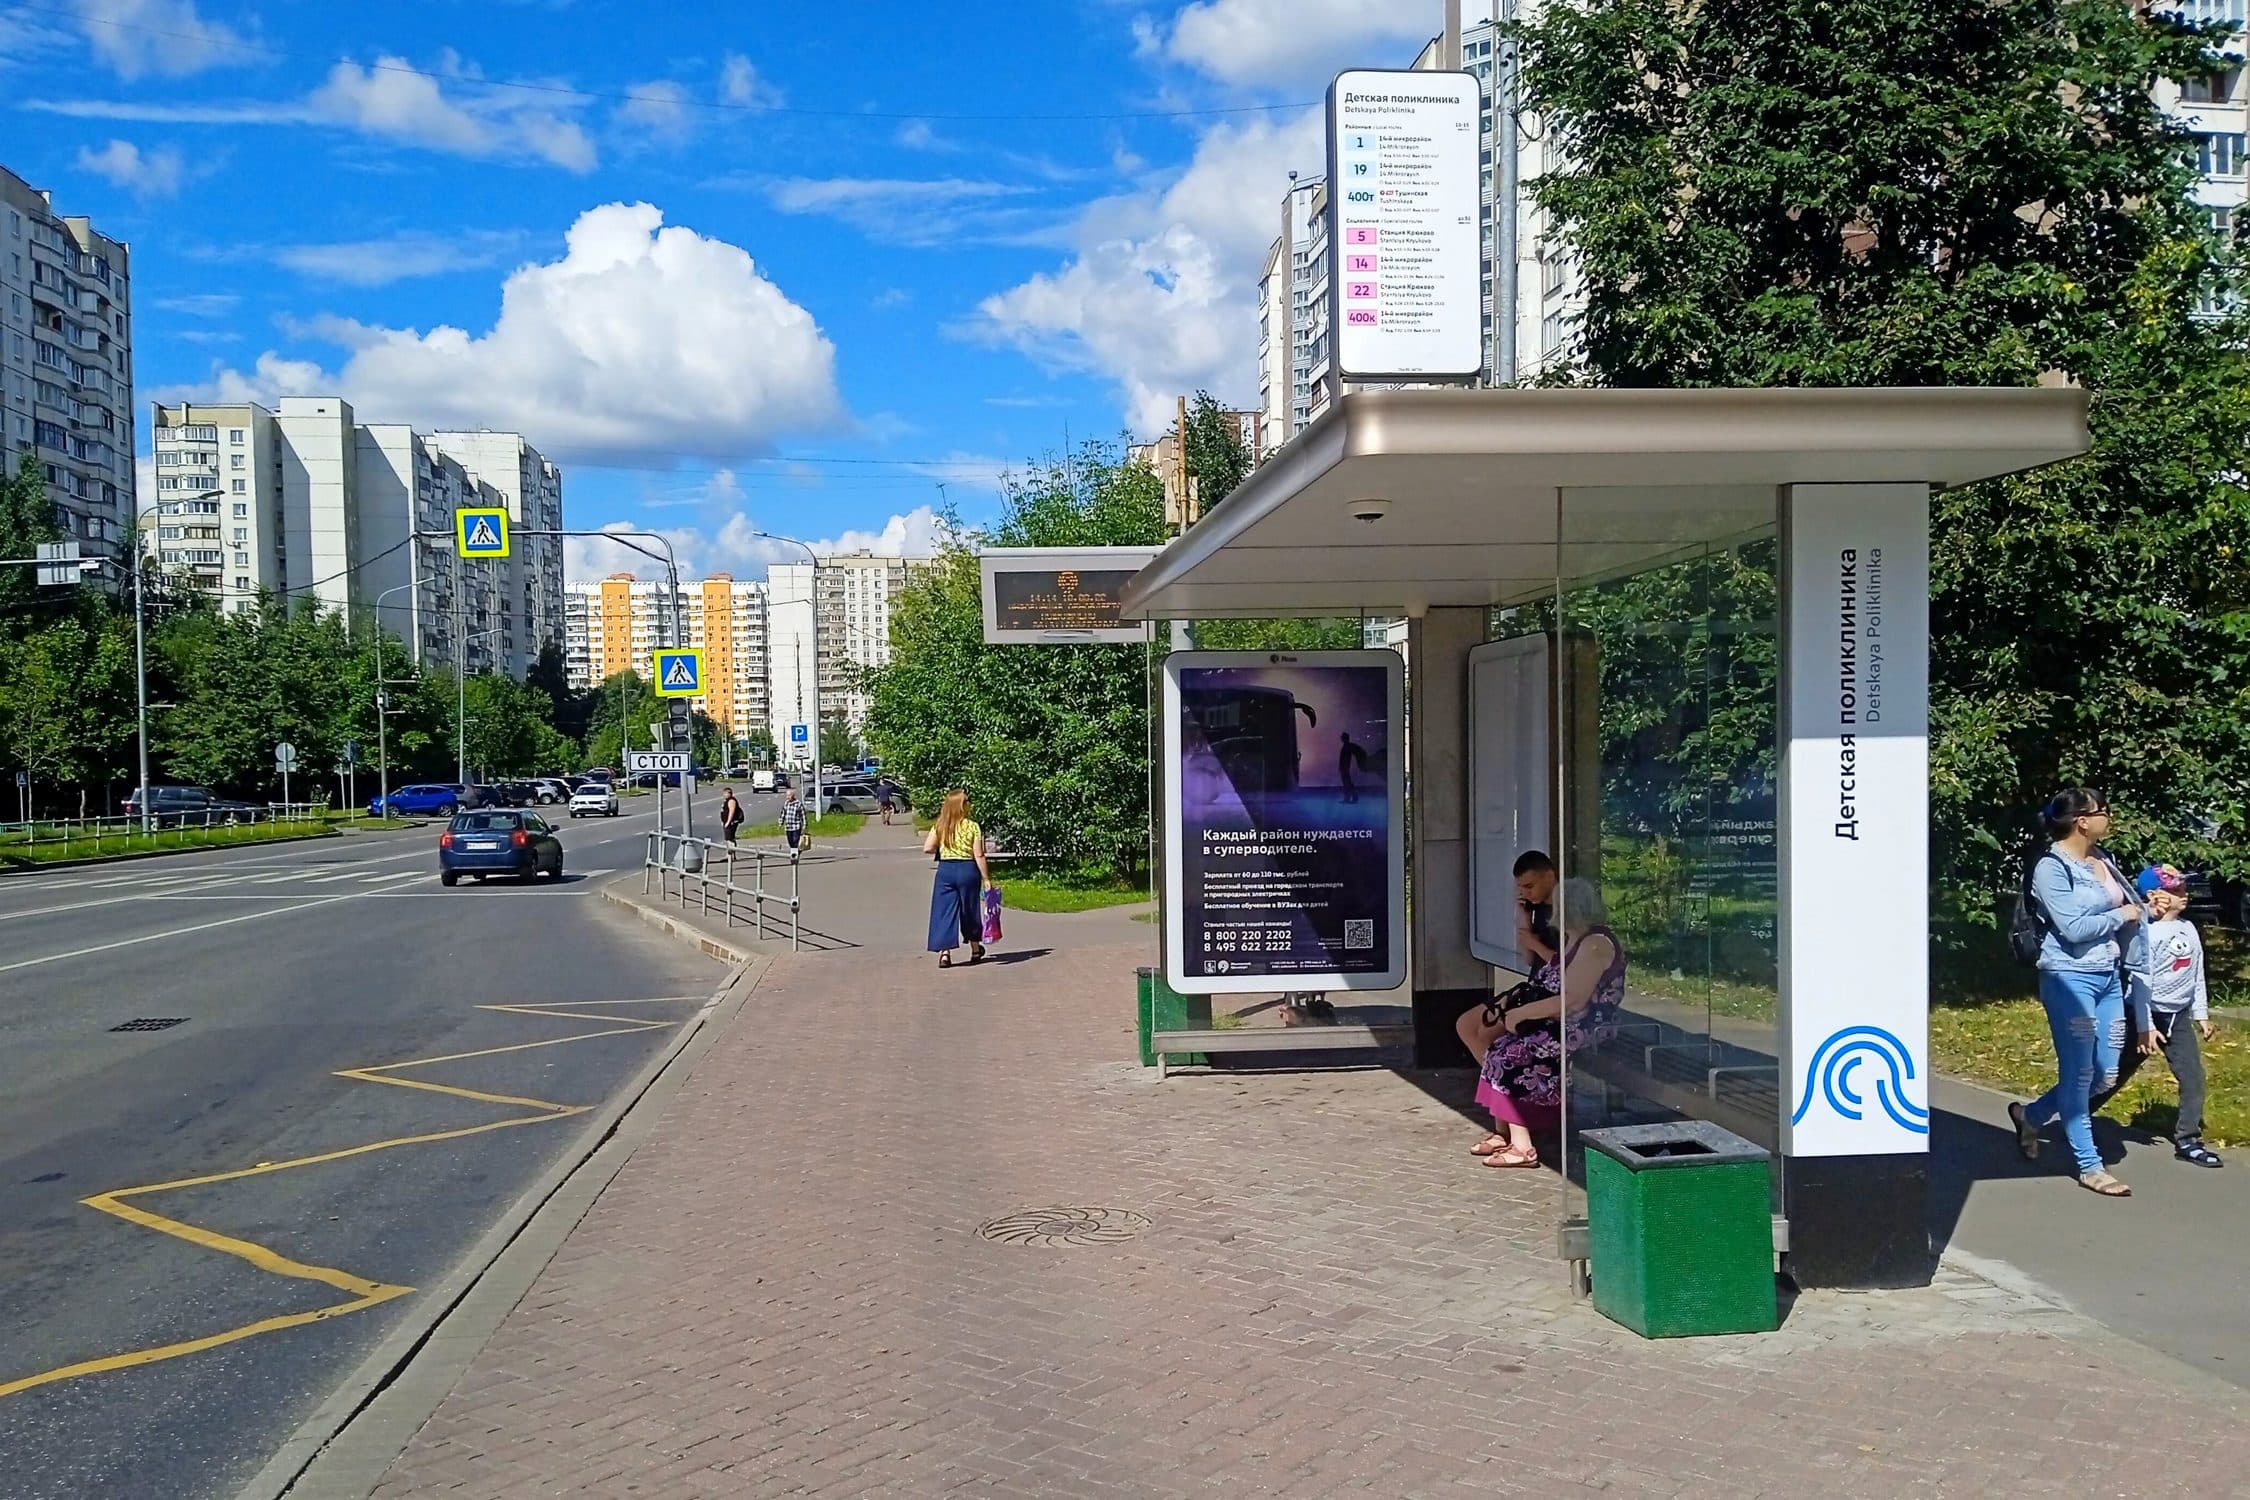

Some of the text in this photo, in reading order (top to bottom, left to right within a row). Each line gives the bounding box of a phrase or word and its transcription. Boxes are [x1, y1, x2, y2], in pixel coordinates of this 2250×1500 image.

[1345, 93, 1460, 104] Детская поликлиника
[1345, 106, 1376, 114] Detskaya
[1357, 138, 1363, 147] 1
[1355, 164, 1367, 175] 19
[1348, 192, 1374, 201] 400т
[1358, 231, 1365, 241] 5
[1355, 259, 1368, 269] 14
[1354, 286, 1369, 296] 22
[1866, 548, 1884, 722] Detskaya Poliklinika
[1835, 549, 1858, 841] Детская поликлиника
[795, 728, 804, 739] P
[638, 756, 681, 768] СТОП
[1203, 828, 1372, 843] Каждый район нуждается
[1214, 844, 1317, 857] суперводителе.
[1204, 930, 1291, 940] 8 800 220 2202
[1204, 941, 1291, 951] 8 495 622 2222
